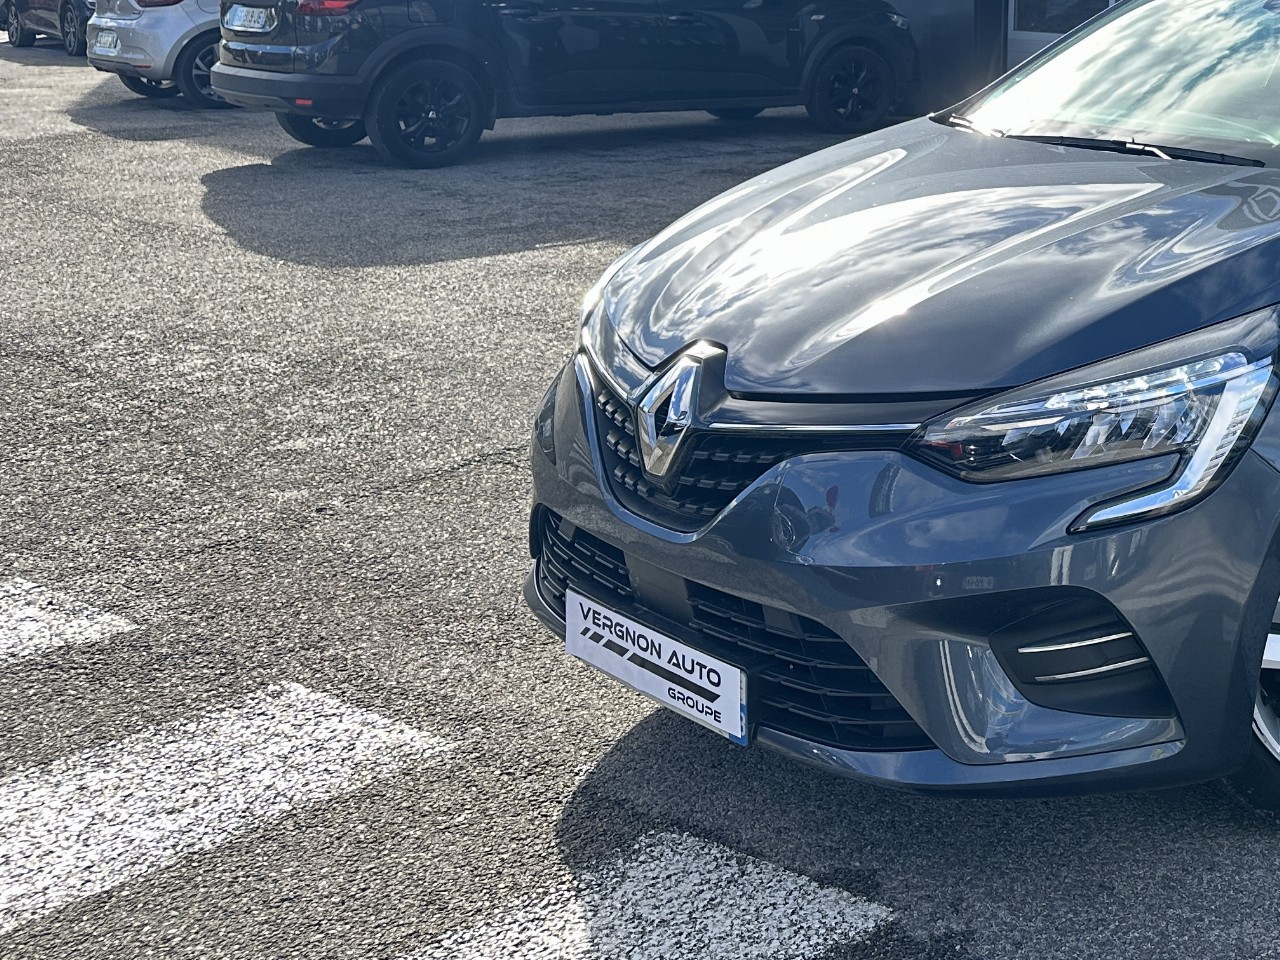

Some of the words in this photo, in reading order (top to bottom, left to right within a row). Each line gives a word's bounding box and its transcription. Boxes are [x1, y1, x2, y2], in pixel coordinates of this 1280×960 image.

[579, 601, 662, 659] VERGNON
[667, 650, 722, 688] AUTO
[668, 687, 722, 723] GROUPE
